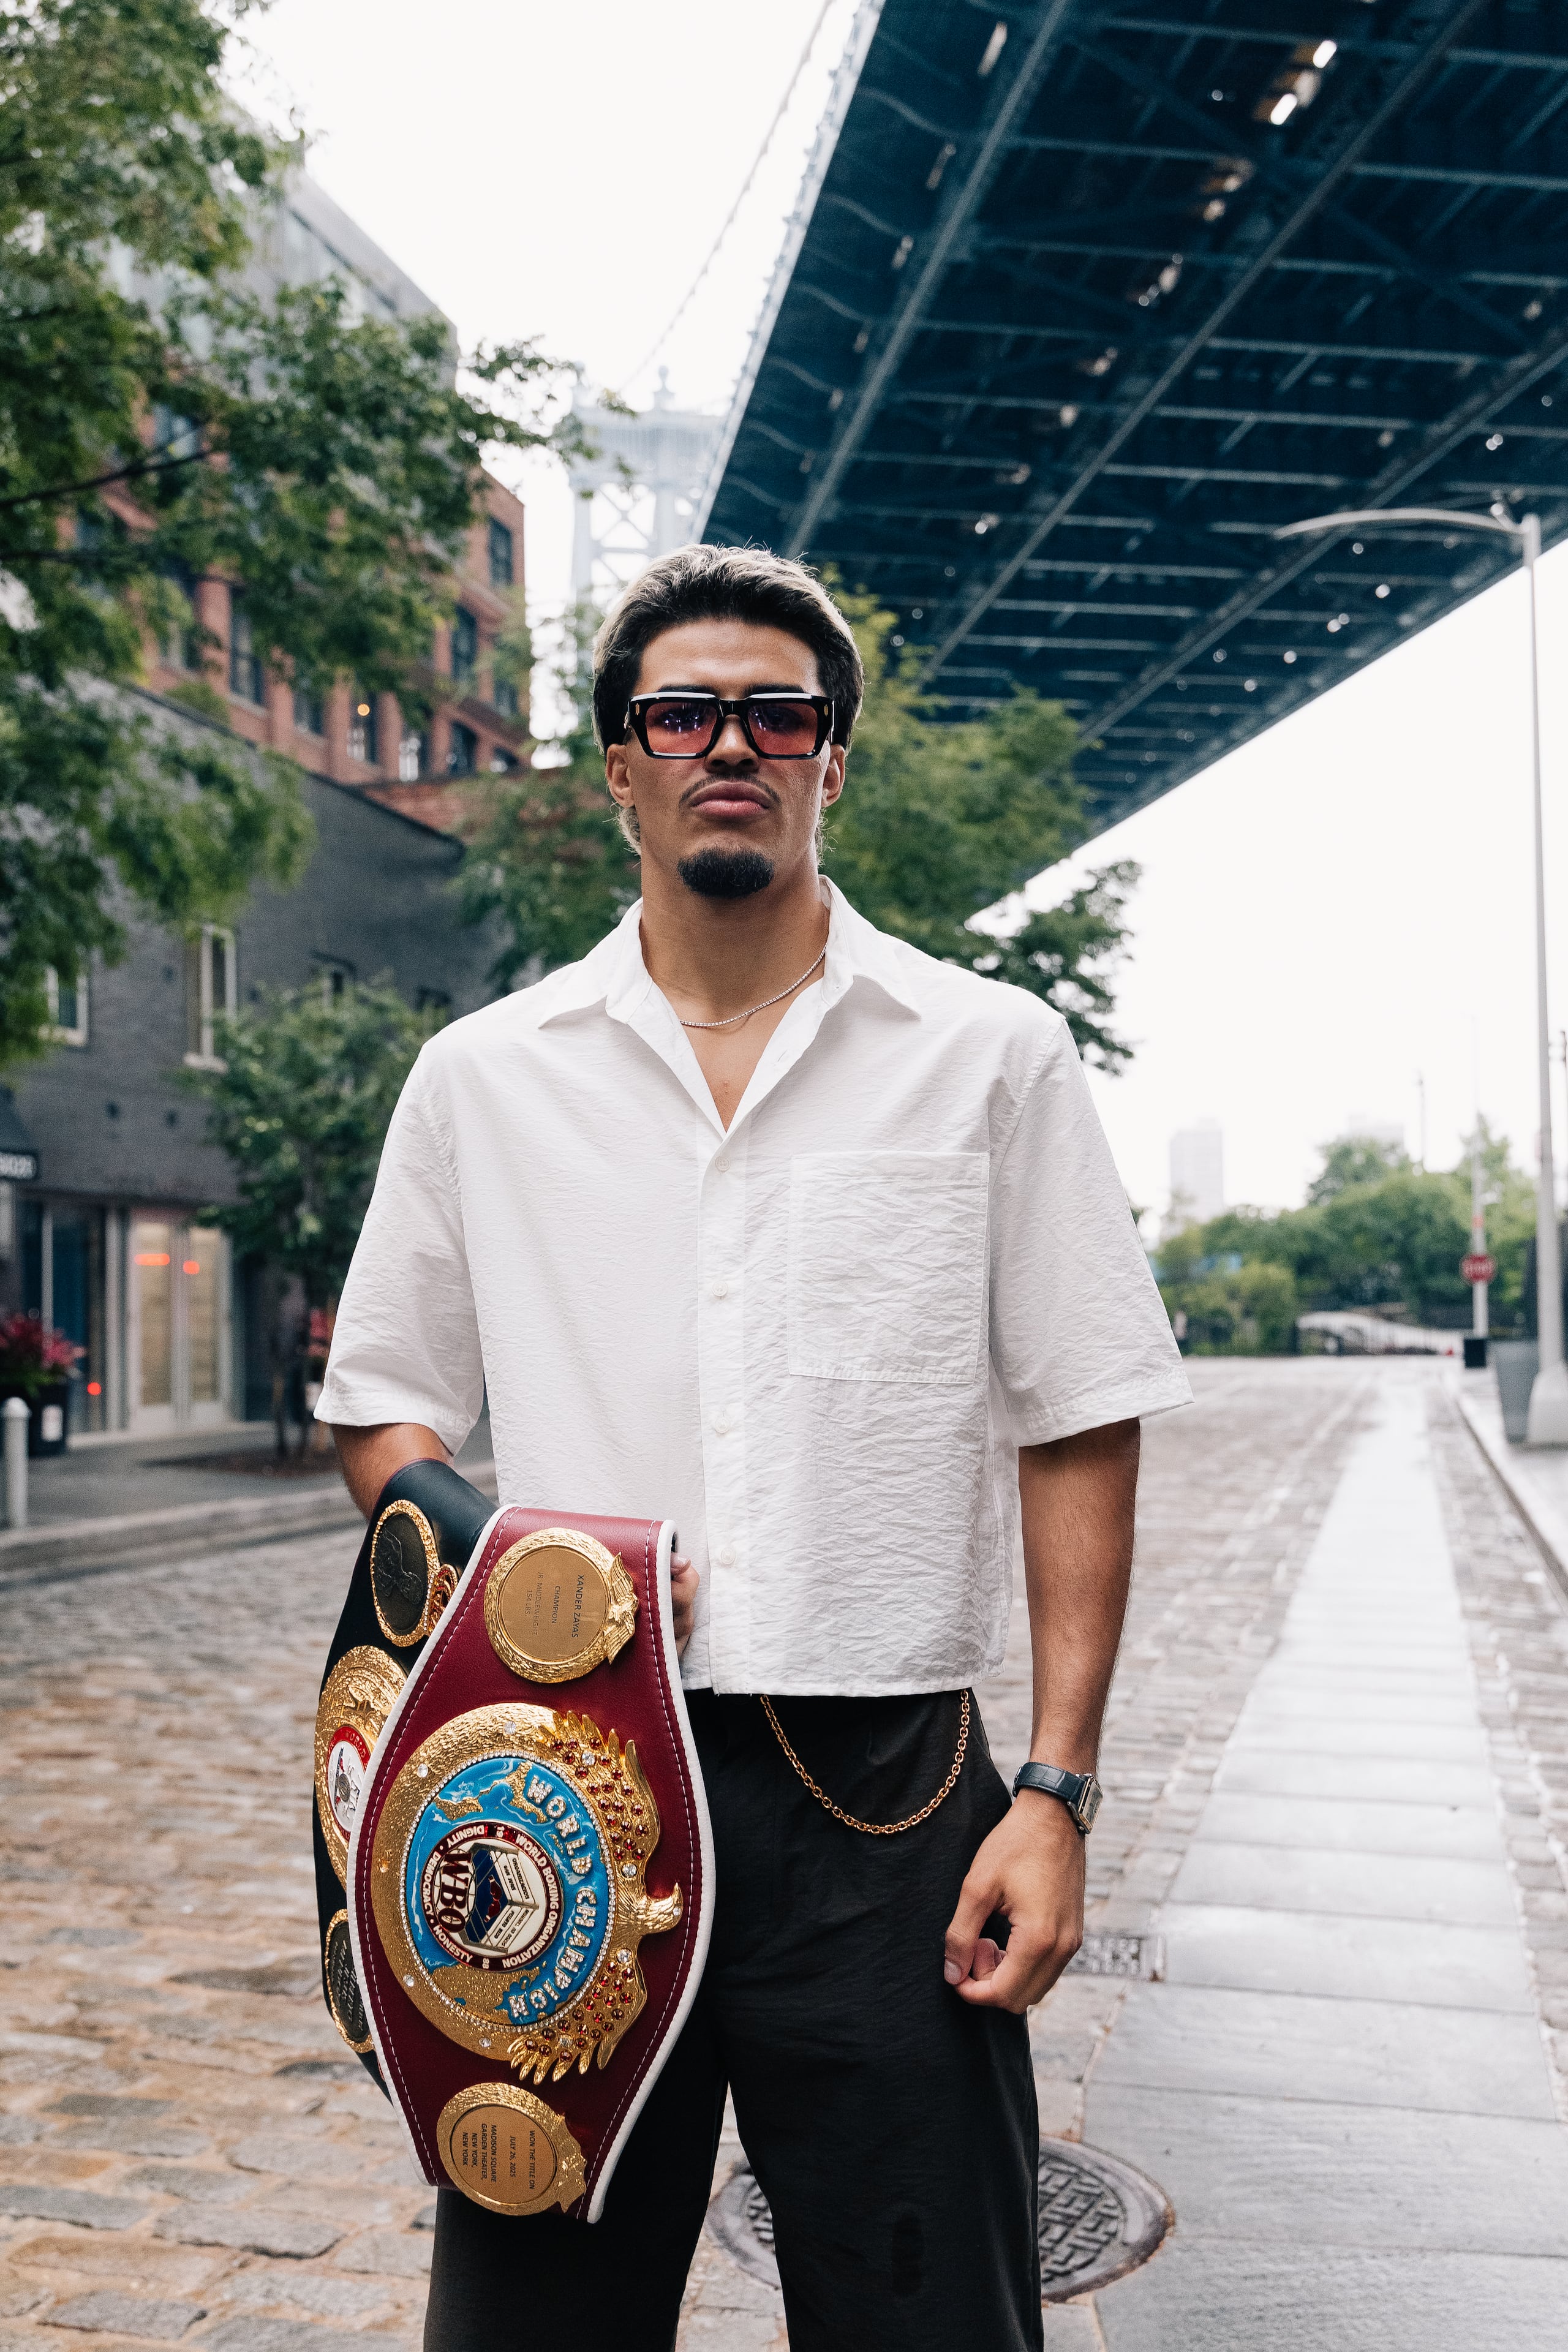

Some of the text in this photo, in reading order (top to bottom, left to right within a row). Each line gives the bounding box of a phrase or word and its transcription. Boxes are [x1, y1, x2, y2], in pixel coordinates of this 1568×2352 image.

[532, 1583, 543, 1635] MIDDLEWEIGHT
[552, 1586, 561, 1624] CHAMPION
[571, 1575, 584, 1638] XANDER ZAYAS
[527, 1775, 593, 1875] WORLD
[422, 1824, 485, 1964] DIGNITY DEMOCRACY HONESTY
[439, 1851, 472, 1934] WBO
[502, 1834, 560, 1969] WORLD BOXING ORGANIZATION
[482, 1958, 489, 1970] 88
[509, 1886, 597, 2018] CHAMPION
[529, 2179, 535, 2190] ON
